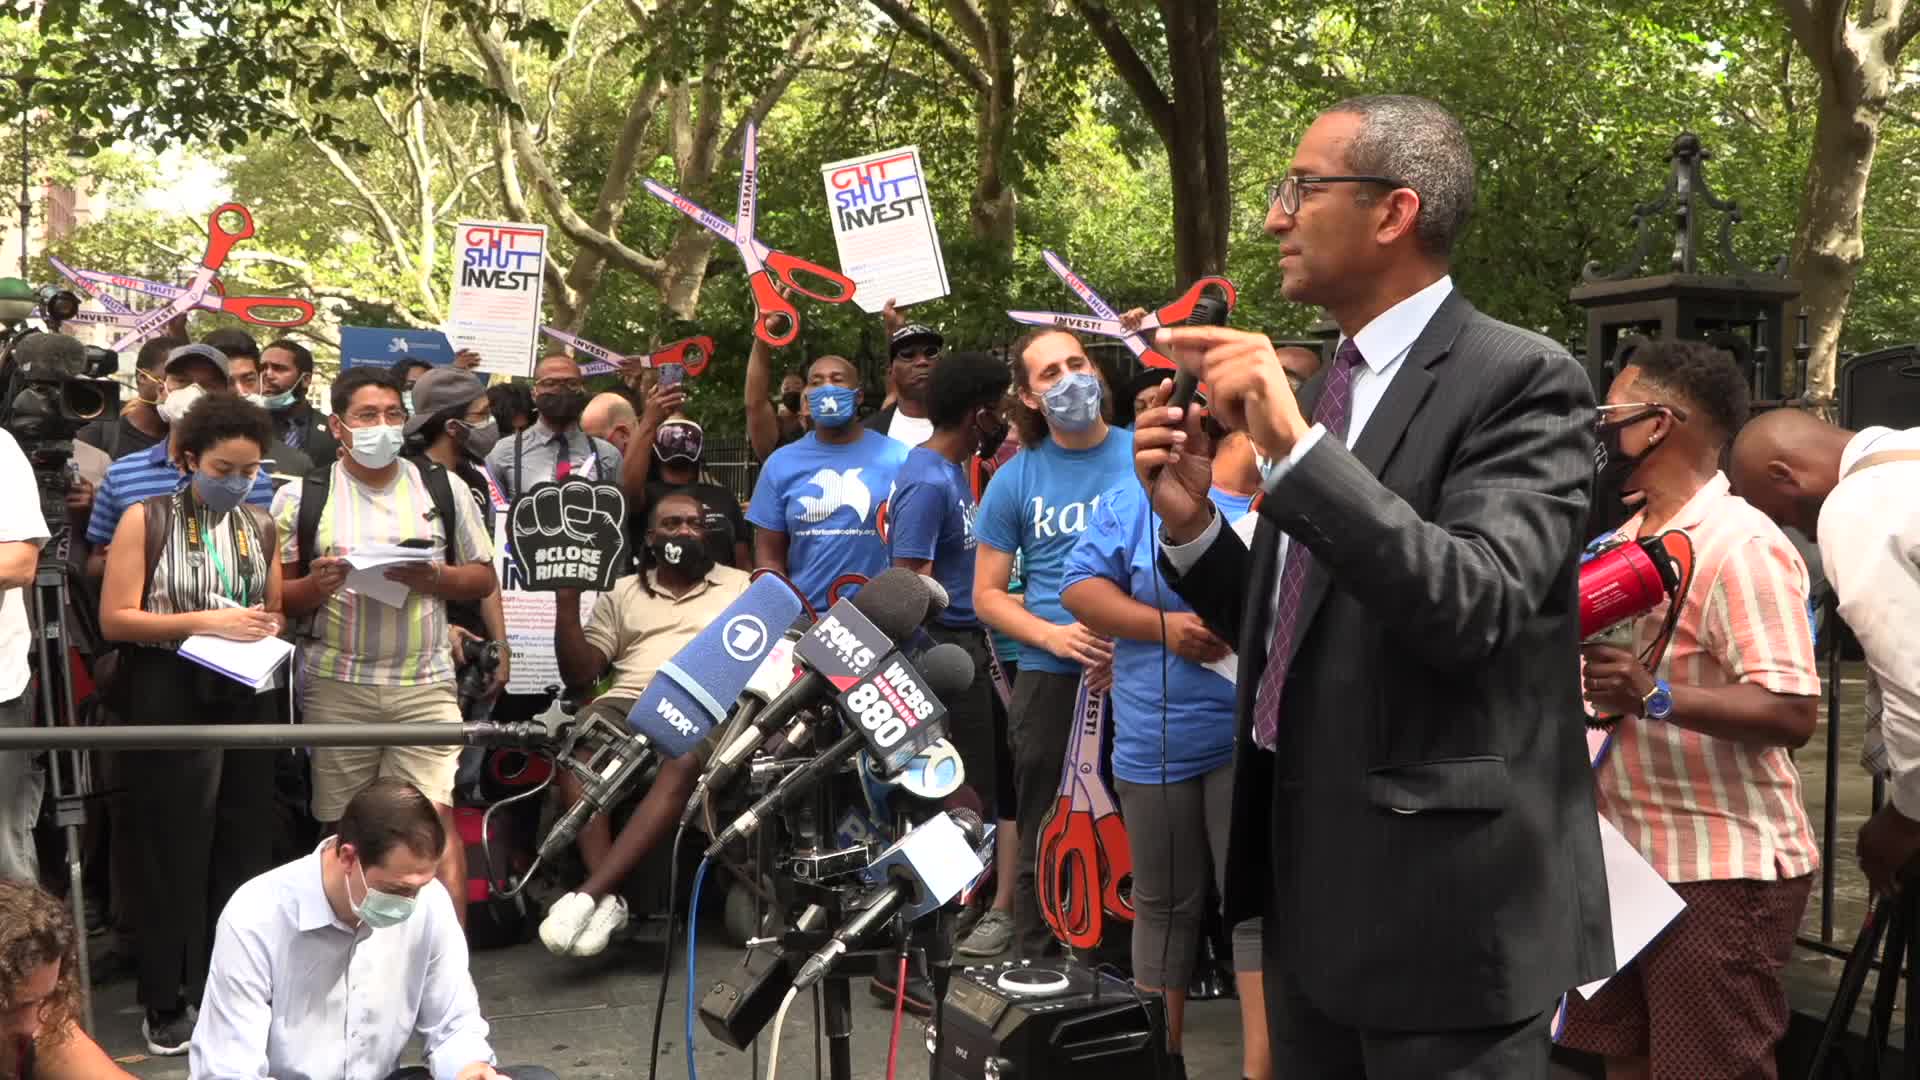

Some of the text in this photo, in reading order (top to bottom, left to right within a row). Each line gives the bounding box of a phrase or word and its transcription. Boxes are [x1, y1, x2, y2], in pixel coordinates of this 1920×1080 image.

[831, 154, 913, 189] CUT
[741, 169, 752, 217] INVEST!
[835, 175, 917, 211] SHUT
[672, 197, 729, 235] CUT! SHUT!
[837, 196, 922, 232] INVEST
[464, 241, 540, 270] SHUT
[466, 228, 544, 248] CUT
[112, 276, 177, 297] CUT! SHUT!
[461, 261, 539, 291] INVEST
[1065, 272, 1114, 321] CUT! SHUT!
[136, 305, 178, 334] INVEST!
[1054, 315, 1101, 331] INVEST!
[573, 339, 609, 360] INVEST!
[535, 546, 602, 565] #CLOSE
[535, 562, 598, 582] RIKERS
[873, 675, 917, 727] NEWSRADIO
[883, 661, 934, 720] WCBS
[847, 683, 907, 747] 880
[1083, 687, 1100, 736] VEST!
